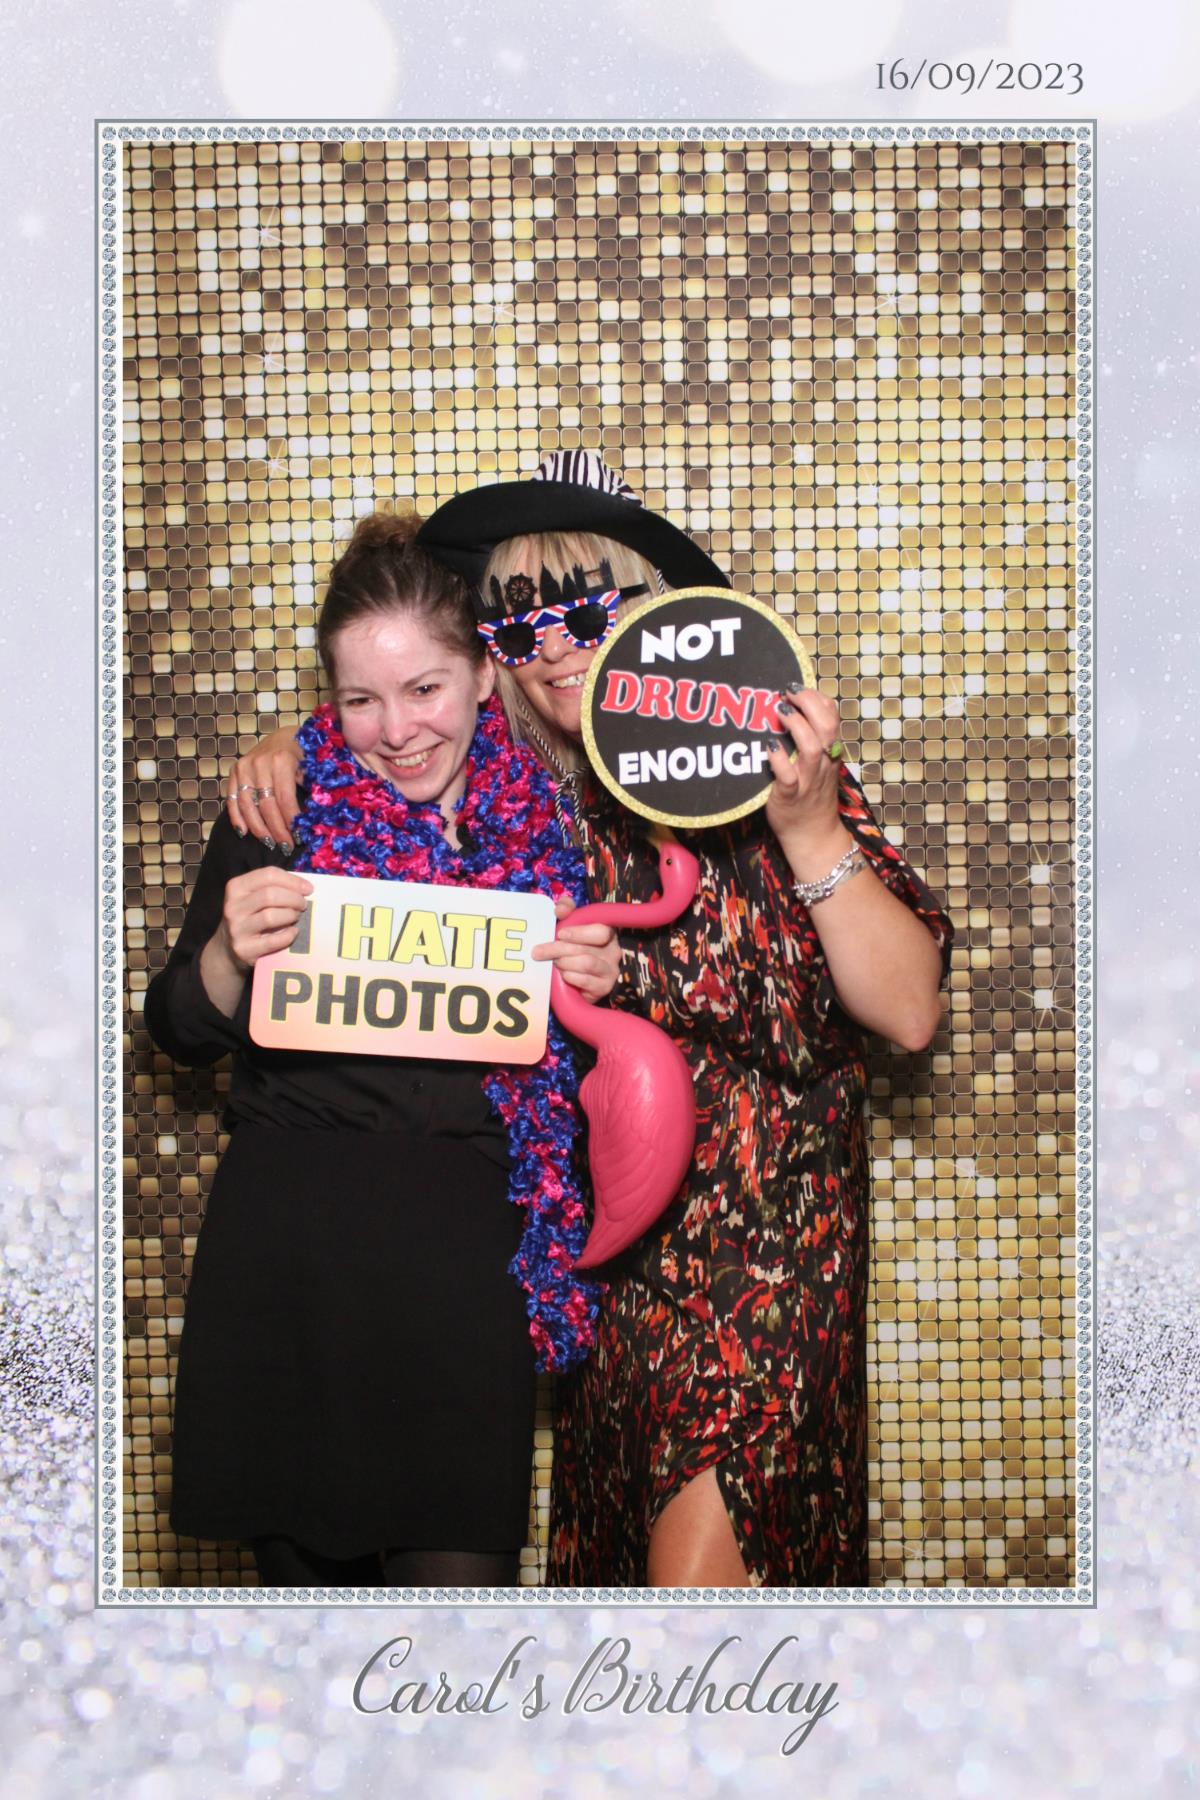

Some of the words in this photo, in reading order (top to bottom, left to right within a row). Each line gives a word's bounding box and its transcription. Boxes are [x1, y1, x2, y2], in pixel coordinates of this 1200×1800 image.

[640, 617, 741, 664] NOT
[601, 670, 786, 733] DRUNK
[337, 903, 527, 972] HATE
[270, 970, 531, 1038] PHOTOS
